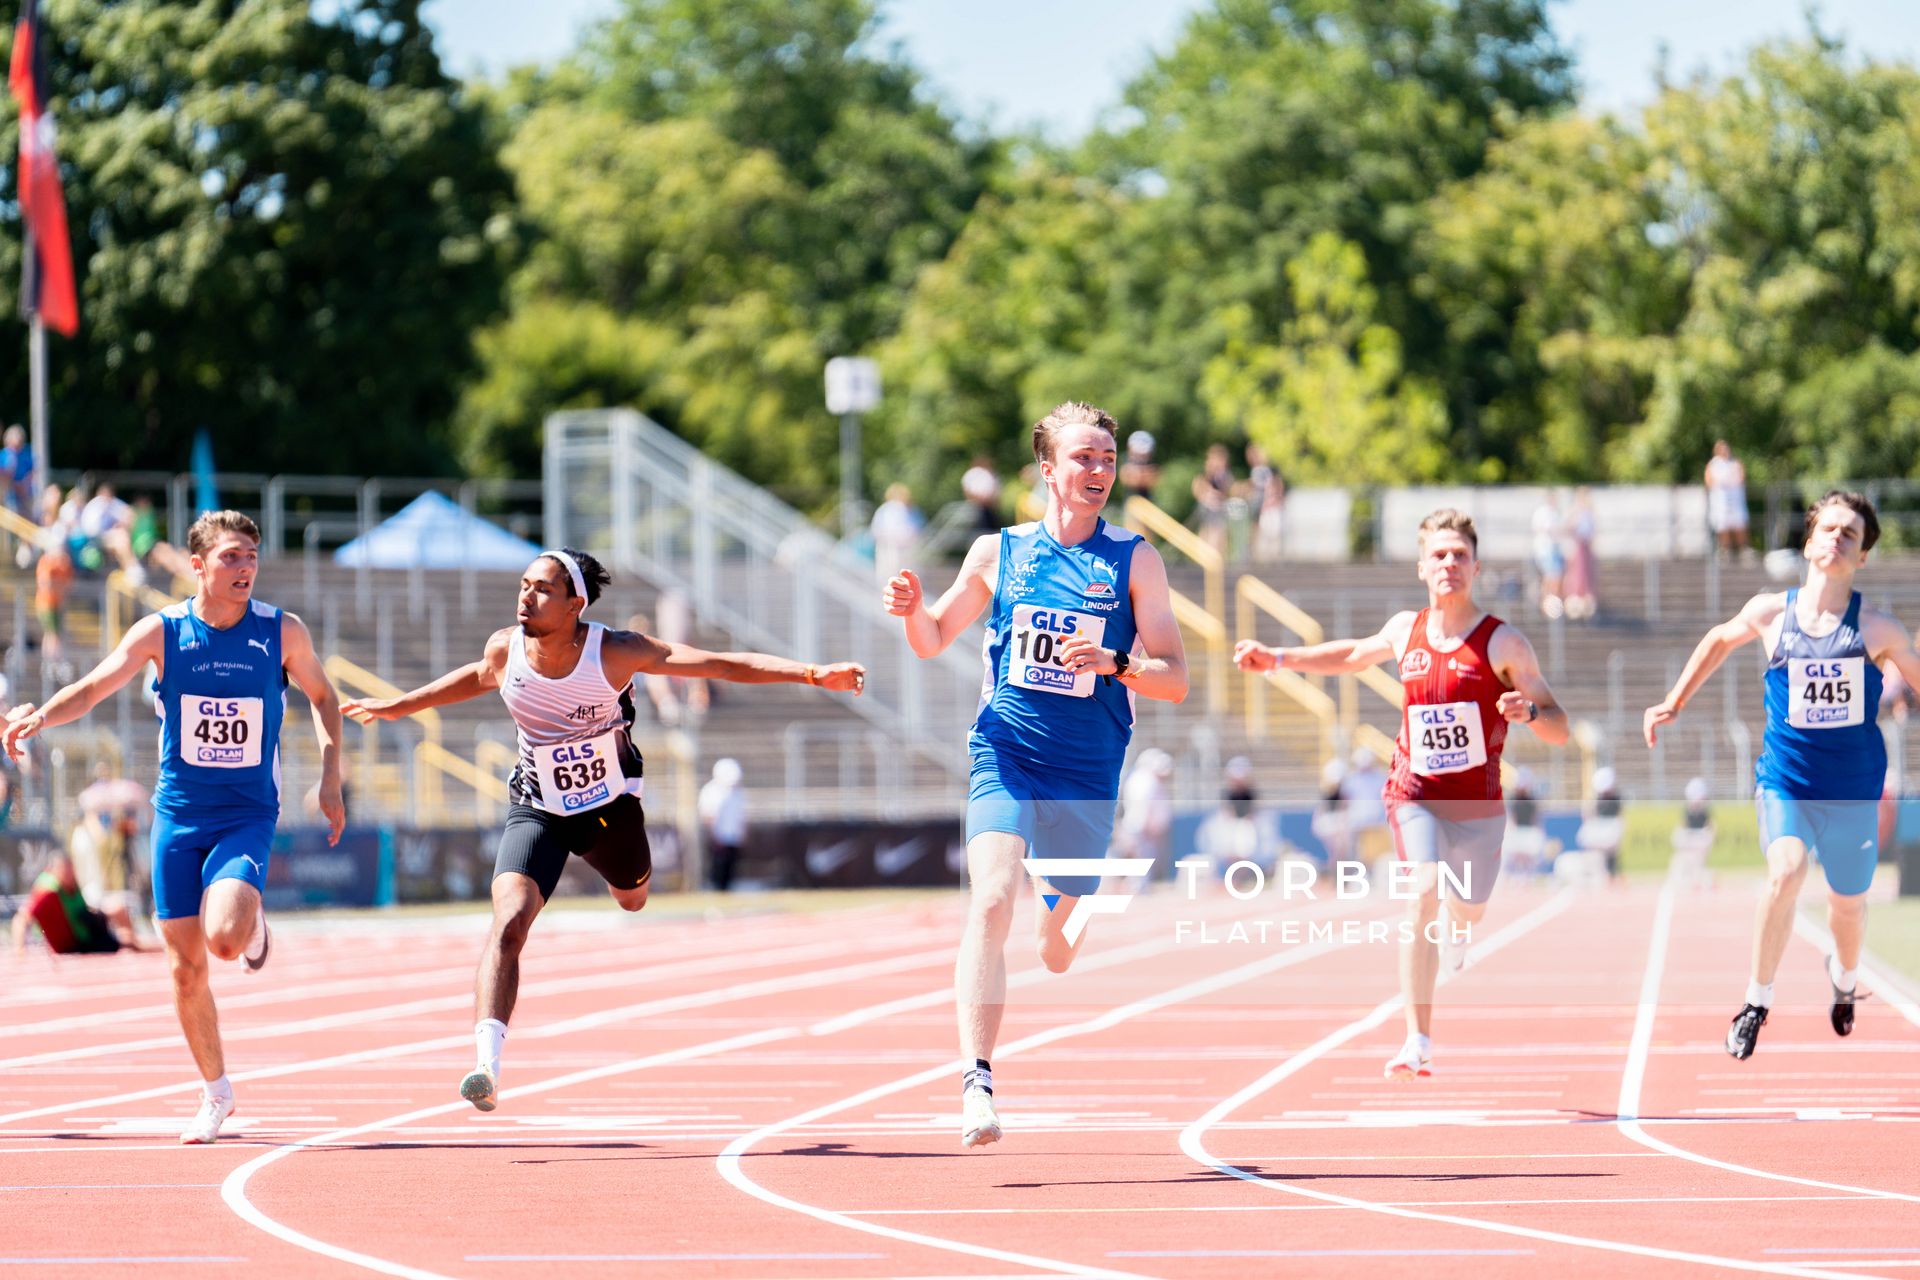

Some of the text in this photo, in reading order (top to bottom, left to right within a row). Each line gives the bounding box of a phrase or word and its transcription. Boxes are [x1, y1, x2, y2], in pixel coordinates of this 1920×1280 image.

[1014, 563, 1037, 573] LAC
[1082, 600, 1113, 611] LINDIG
[212, 661, 253, 672] Benjamin
[1044, 671, 1073, 683] PLAN
[1803, 681, 1851, 704] 445
[566, 704, 603, 720] ART
[194, 719, 249, 744] 430
[1422, 725, 1469, 750] 458
[216, 749, 242, 758] PLAN
[553, 758, 607, 791] 638
[581, 784, 606, 801] PLAN
